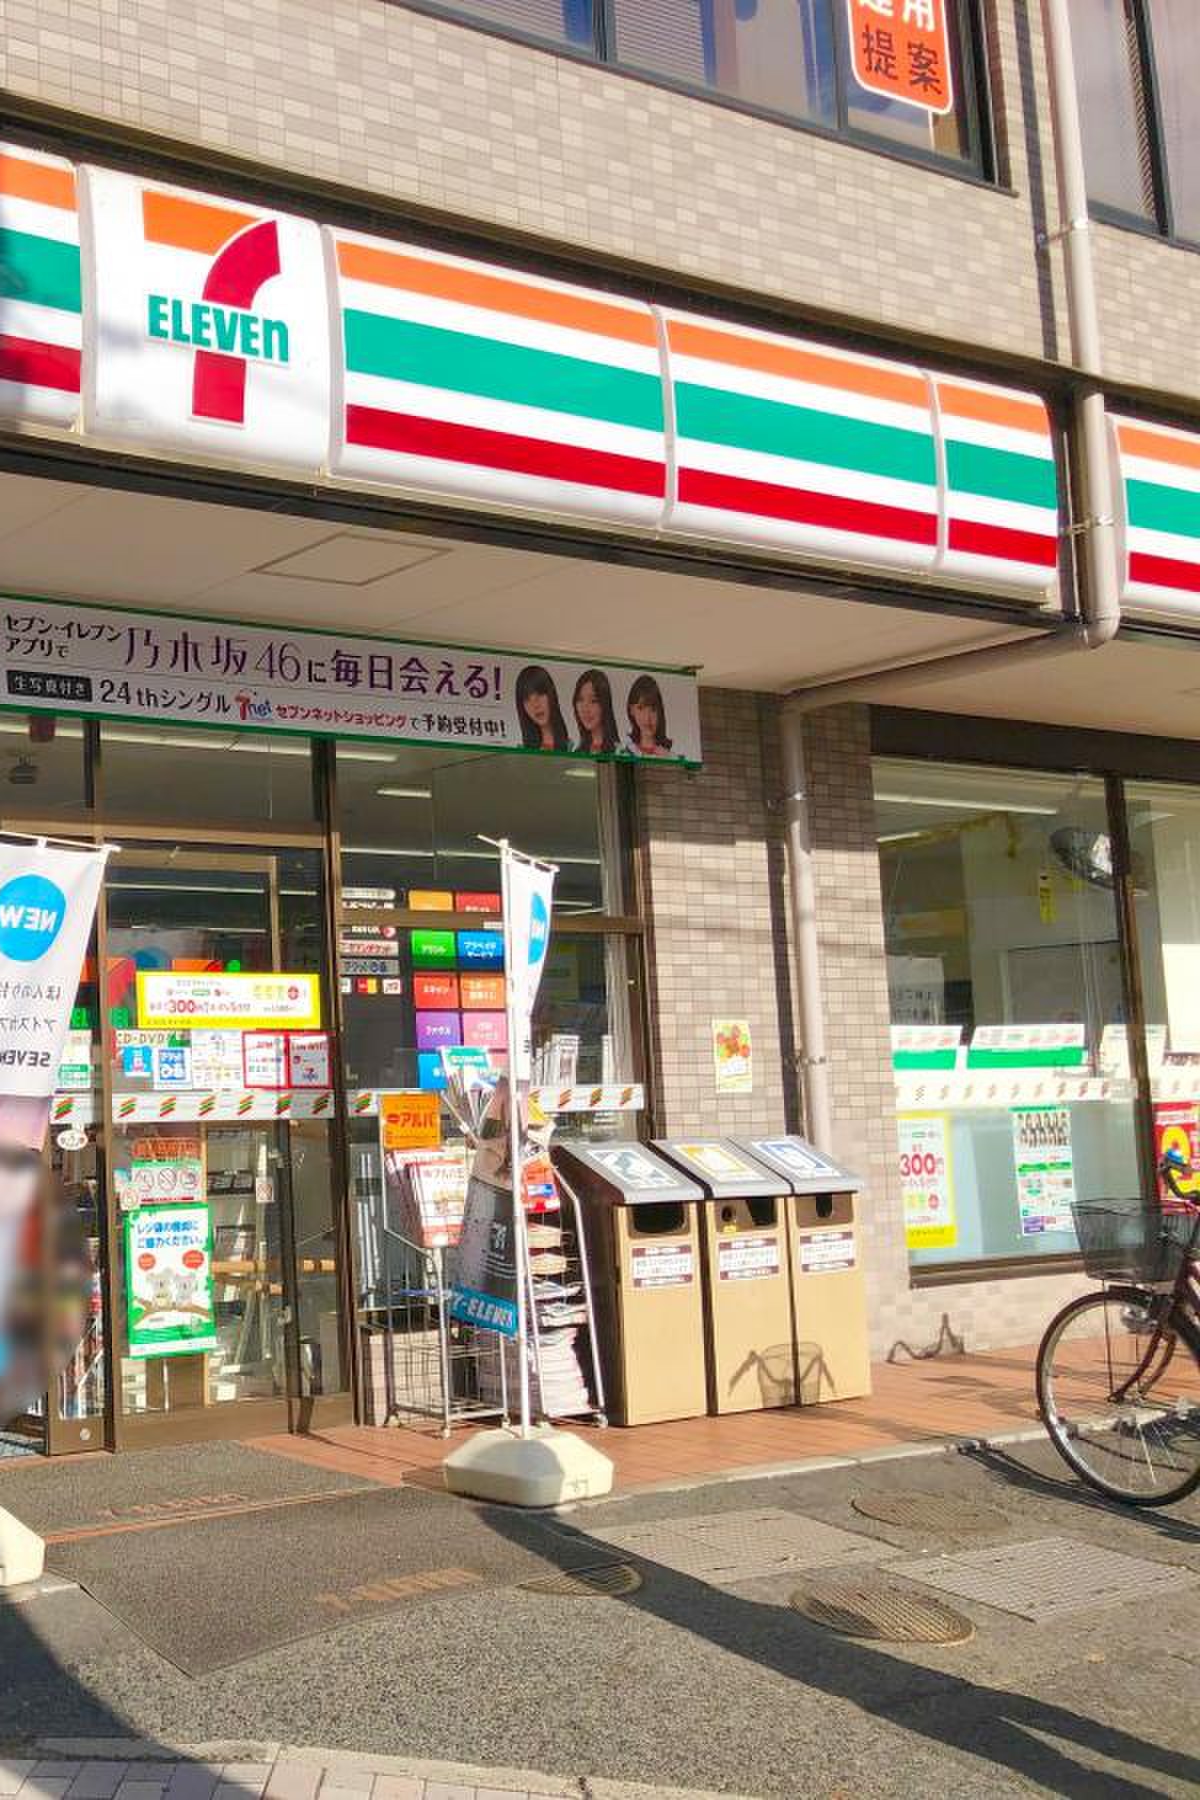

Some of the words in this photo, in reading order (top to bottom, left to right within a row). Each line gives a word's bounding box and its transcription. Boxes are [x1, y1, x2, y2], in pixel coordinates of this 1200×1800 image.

[862, 23, 942, 95] 提案
[5, 636, 69, 658] アプリで
